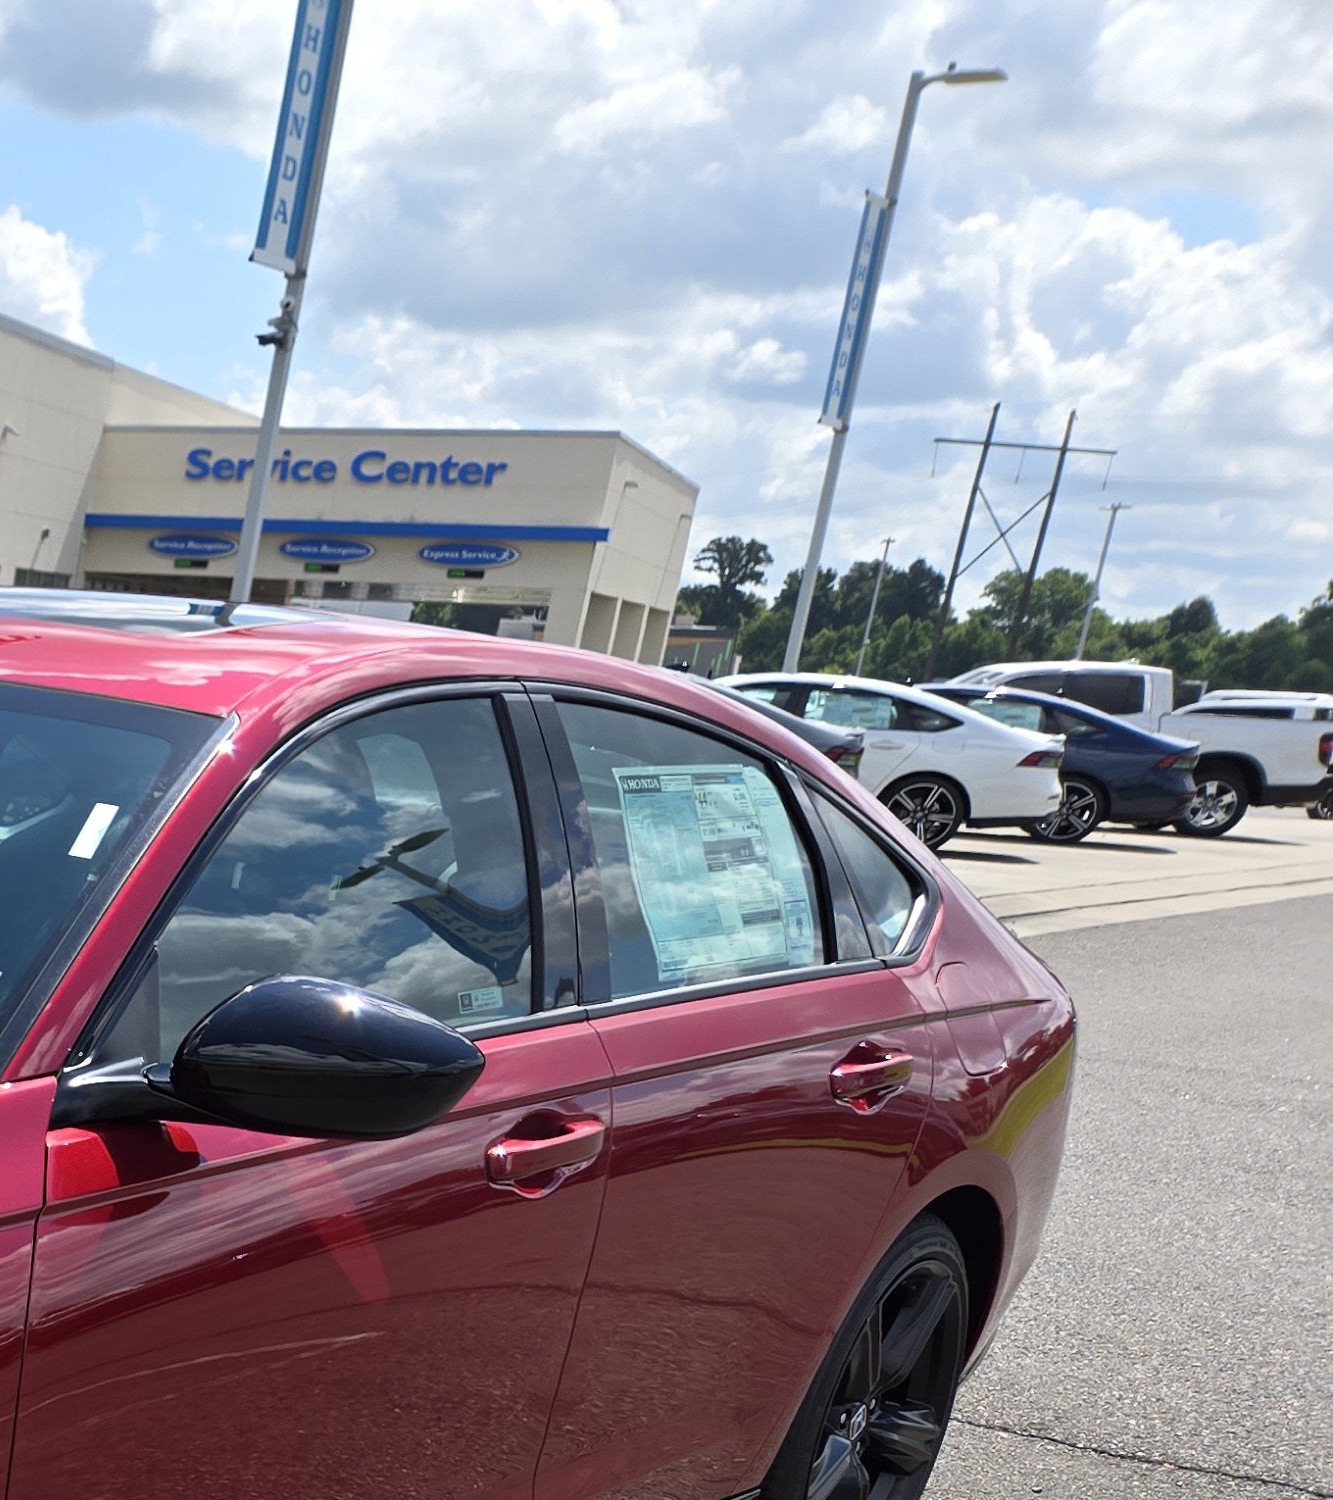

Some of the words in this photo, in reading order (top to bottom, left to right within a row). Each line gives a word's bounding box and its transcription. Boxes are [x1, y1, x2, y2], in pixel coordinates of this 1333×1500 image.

[273, 24, 320, 225] HONDA
[350, 450, 508, 487] Center
[461, 549, 497, 560] Service
[627, 778, 661, 790] HONDA
